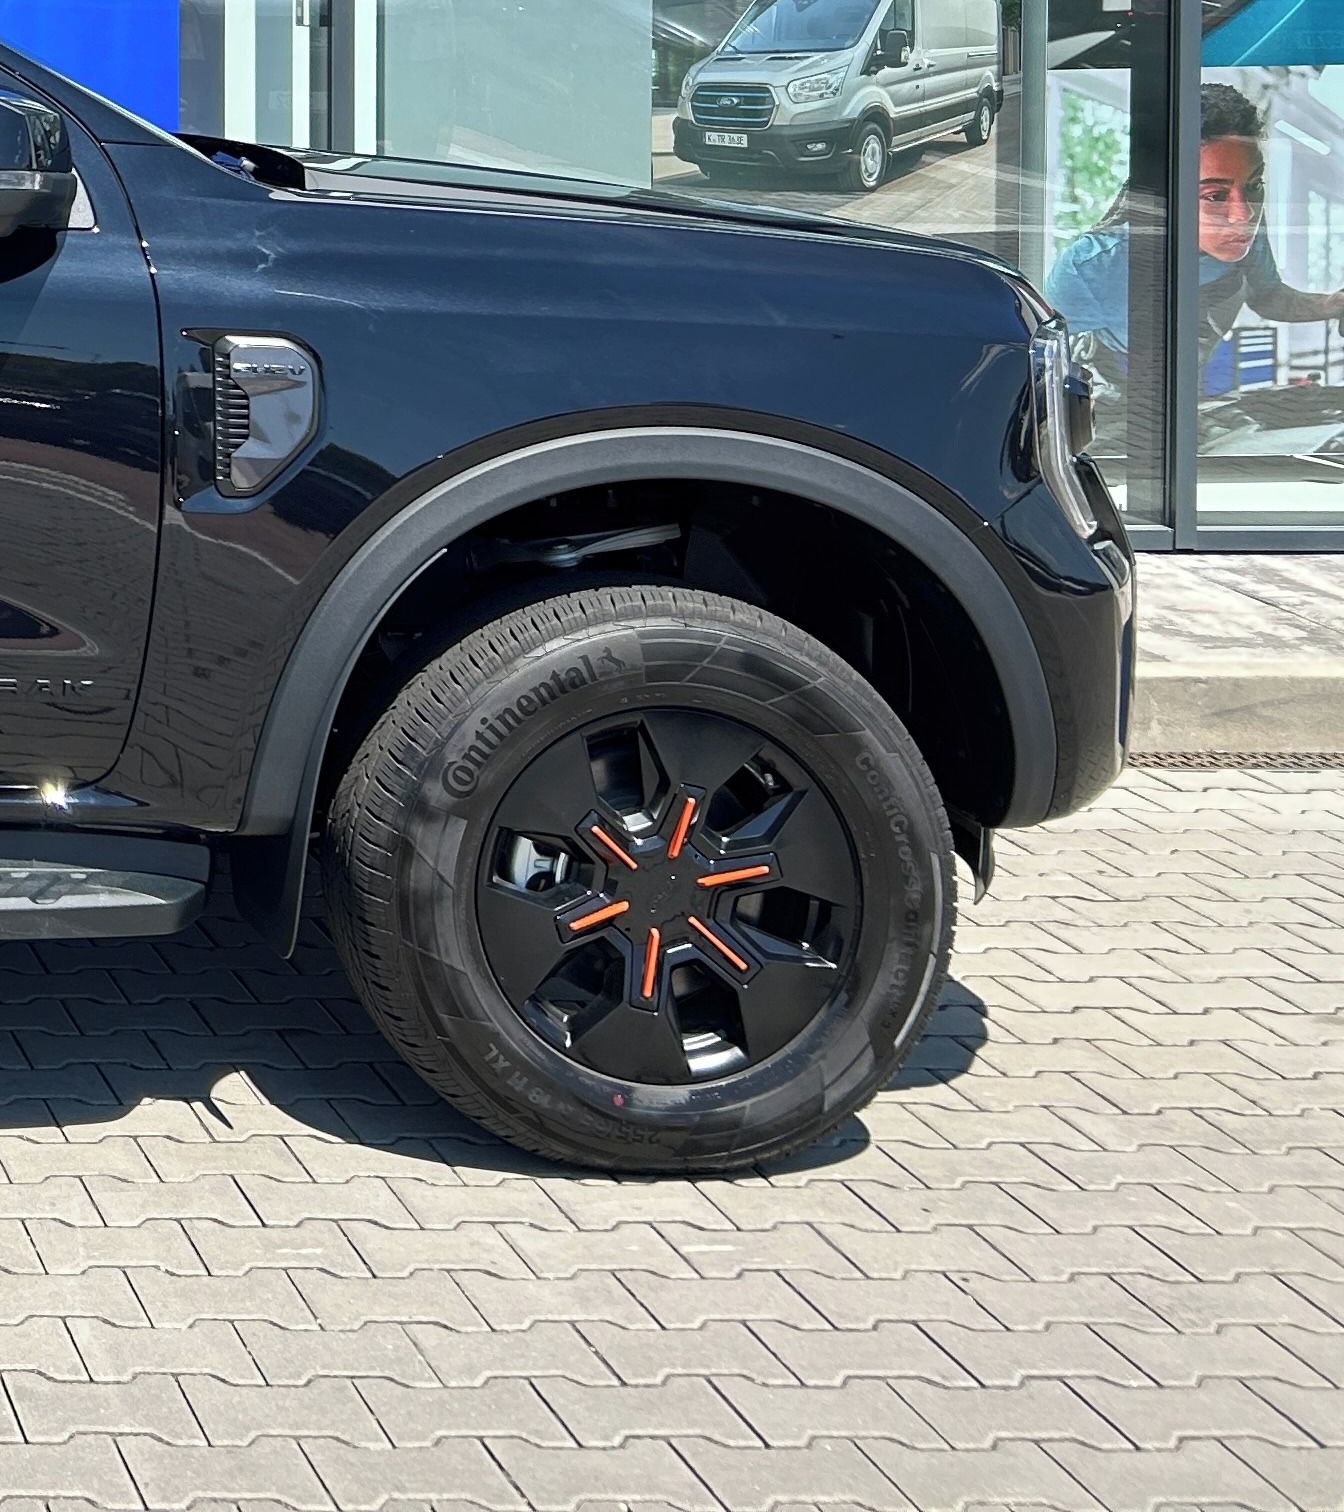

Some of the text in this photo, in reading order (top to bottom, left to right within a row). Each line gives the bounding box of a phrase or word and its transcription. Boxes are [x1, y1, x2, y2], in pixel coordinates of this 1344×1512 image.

[442, 654, 600, 798] Continental
[481, 1041, 513, 1078] XL
[527, 1087, 553, 1109] 18
